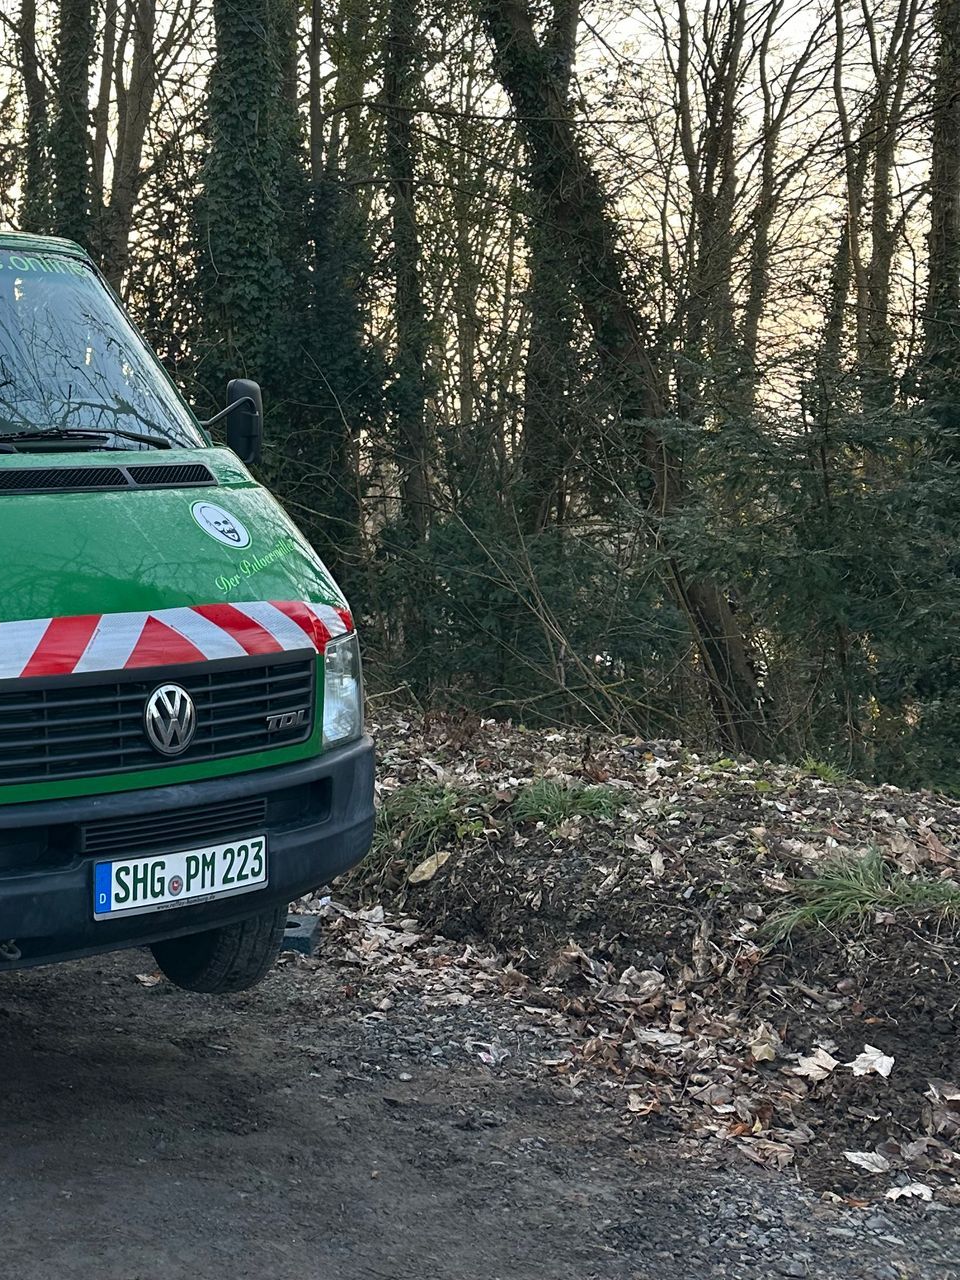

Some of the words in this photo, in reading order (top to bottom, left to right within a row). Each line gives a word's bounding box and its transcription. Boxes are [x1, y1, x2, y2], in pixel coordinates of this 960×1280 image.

[214, 572, 241, 595] Der
[145, 681, 197, 756] VW
[266, 709, 306, 731] TDI
[99, 893, 107, 905] D
[114, 860, 166, 904] SHG
[185, 851, 216, 892] PM
[222, 840, 264, 885] 223
